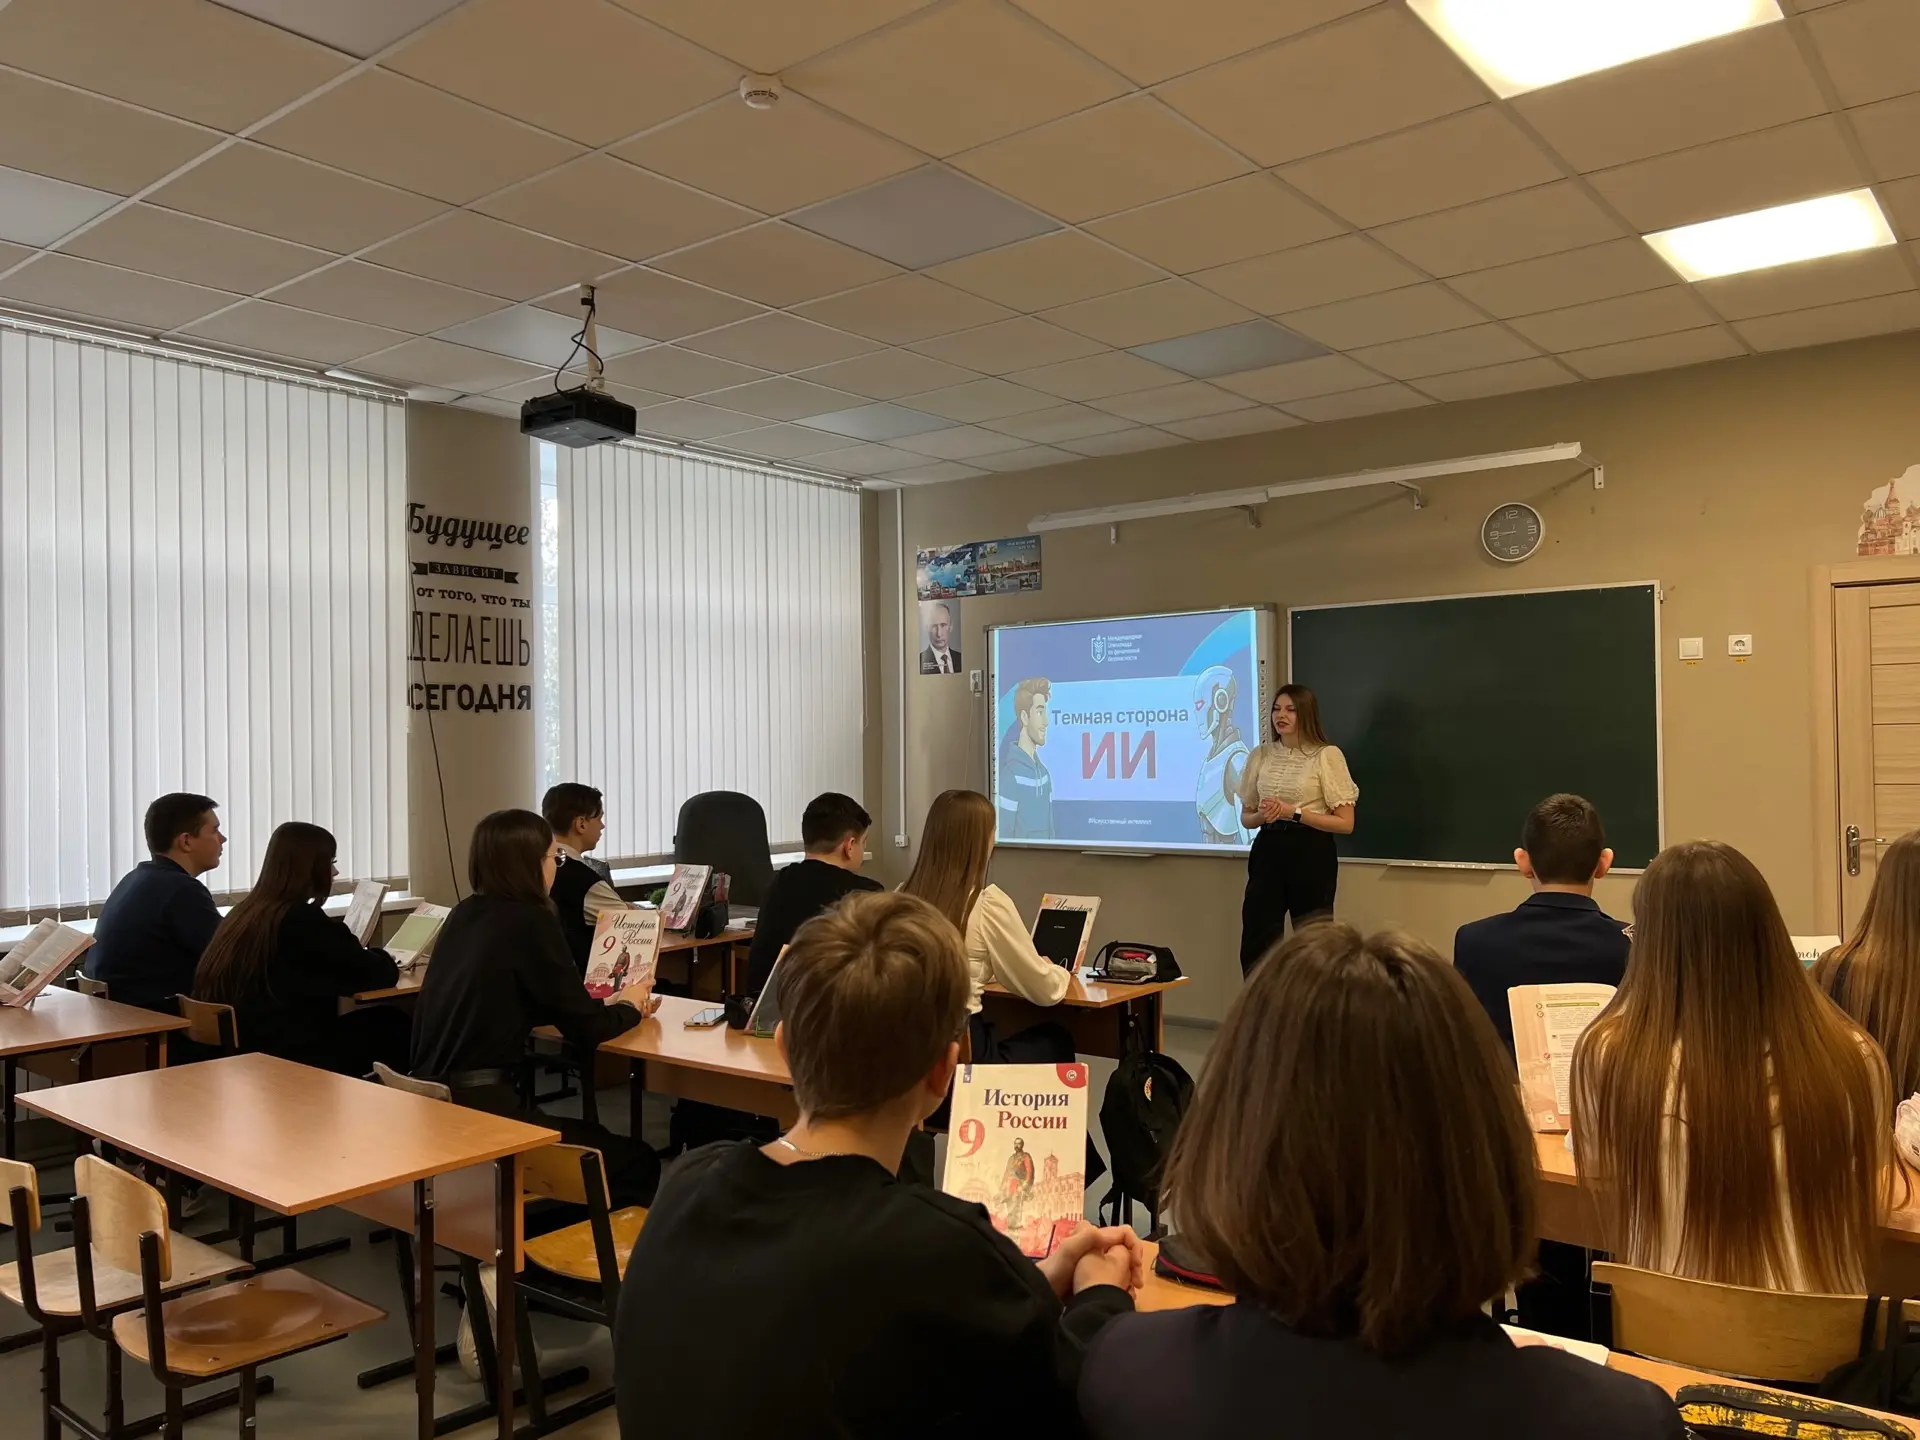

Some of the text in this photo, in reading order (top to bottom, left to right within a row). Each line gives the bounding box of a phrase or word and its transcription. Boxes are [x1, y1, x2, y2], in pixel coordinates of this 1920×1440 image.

[1505, 509, 1519, 520] 12
[407, 503, 529, 551] Будущее
[1527, 524, 1537, 535] 3
[1509, 545, 1520, 555] 6
[435, 563, 499, 578] ЗАВИСИТ
[407, 611, 530, 666] ДЕЛАЕШЬ
[406, 683, 531, 713] СЕГОДНЯ
[1051, 708, 1189, 727] Темная сторона
[1082, 730, 1156, 779] ИИ
[670, 882, 682, 897] 9
[611, 912, 656, 934] История
[598, 935, 616, 956] 9
[621, 929, 653, 945] России
[984, 1088, 1069, 1111] История
[997, 1110, 1068, 1129] России
[956, 1118, 985, 1158] 9
